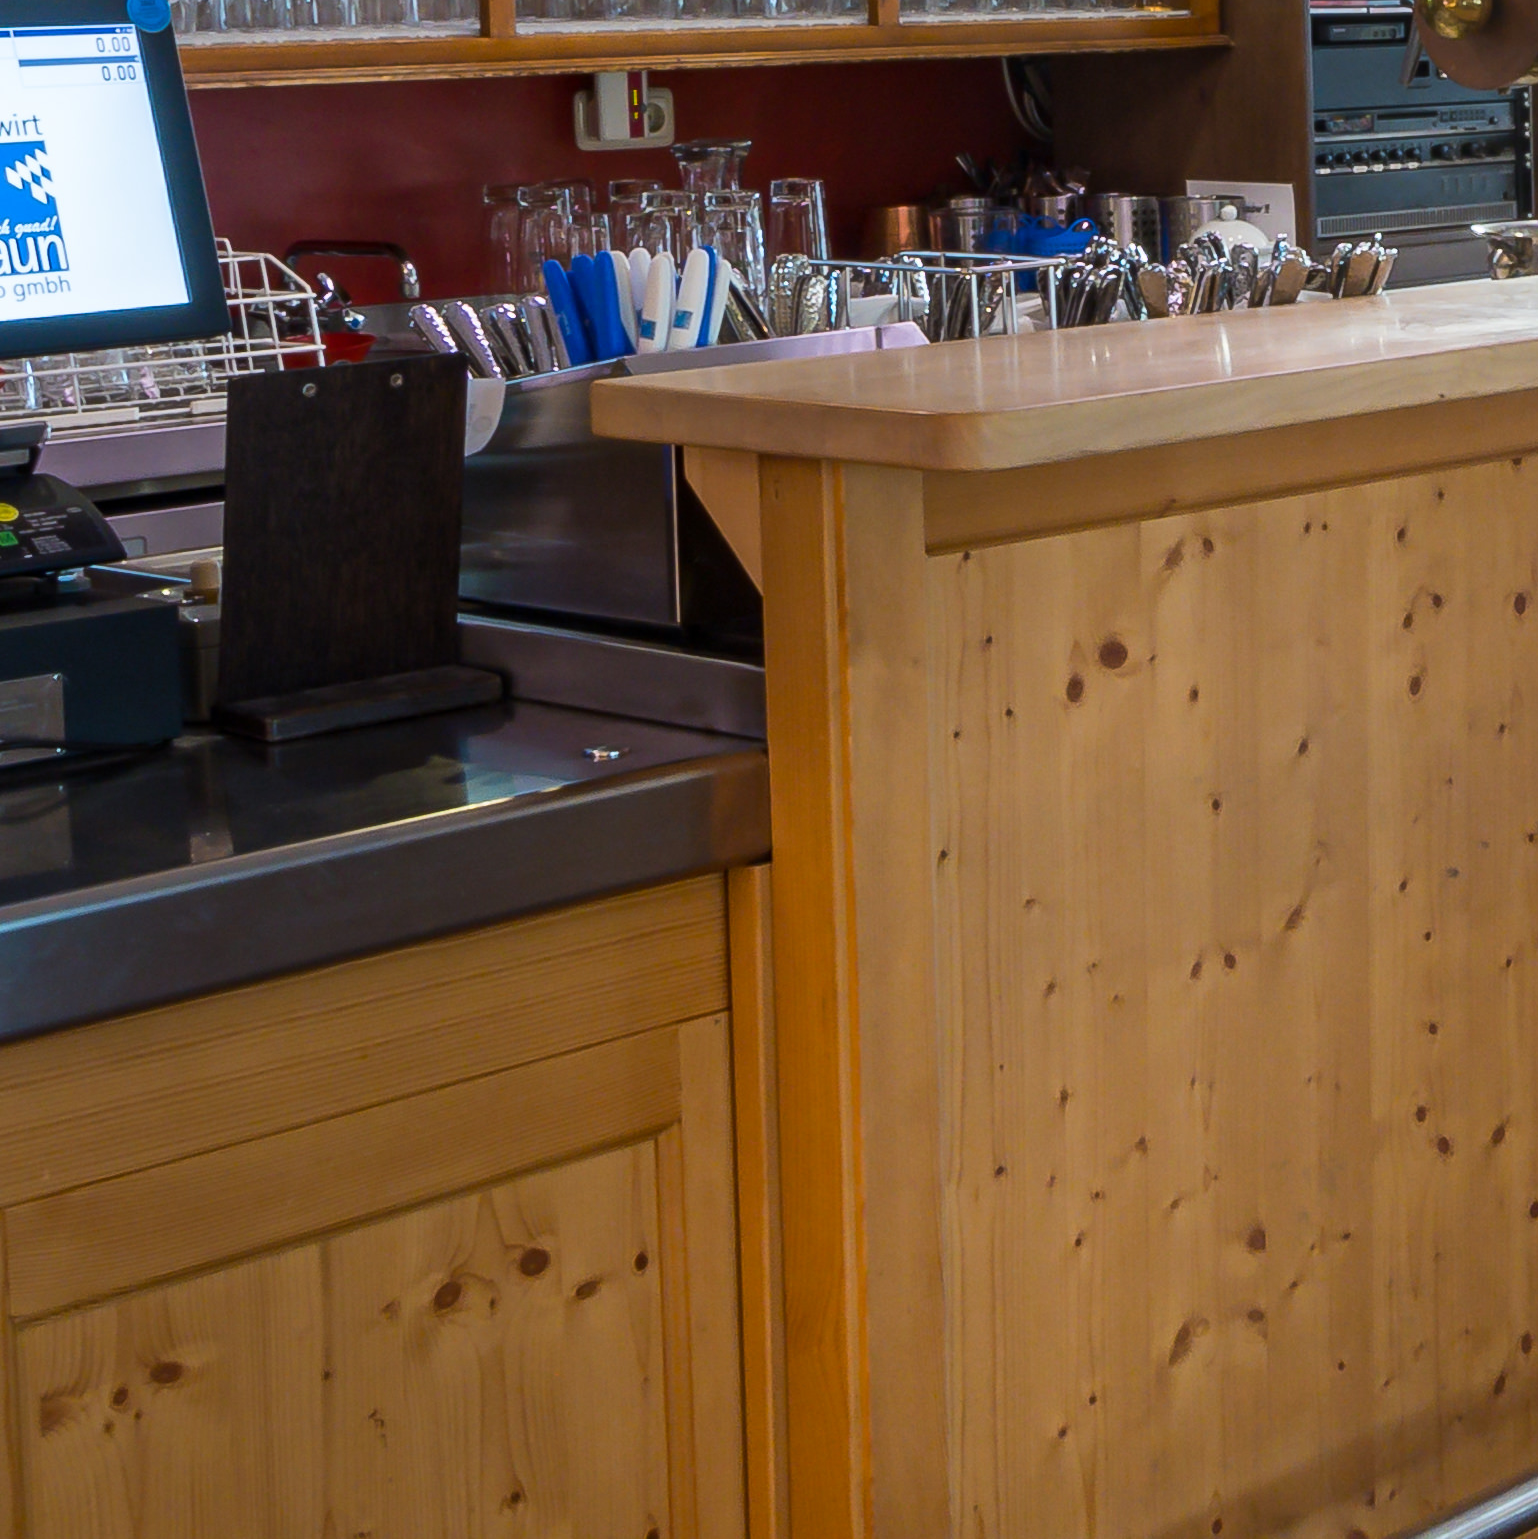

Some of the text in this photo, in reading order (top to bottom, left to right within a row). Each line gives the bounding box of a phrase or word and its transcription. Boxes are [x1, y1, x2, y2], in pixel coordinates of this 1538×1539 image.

[96, 36, 131, 53] 0.00
[102, 65, 137, 81] 0.00
[13, 276, 71, 302] gmbh
